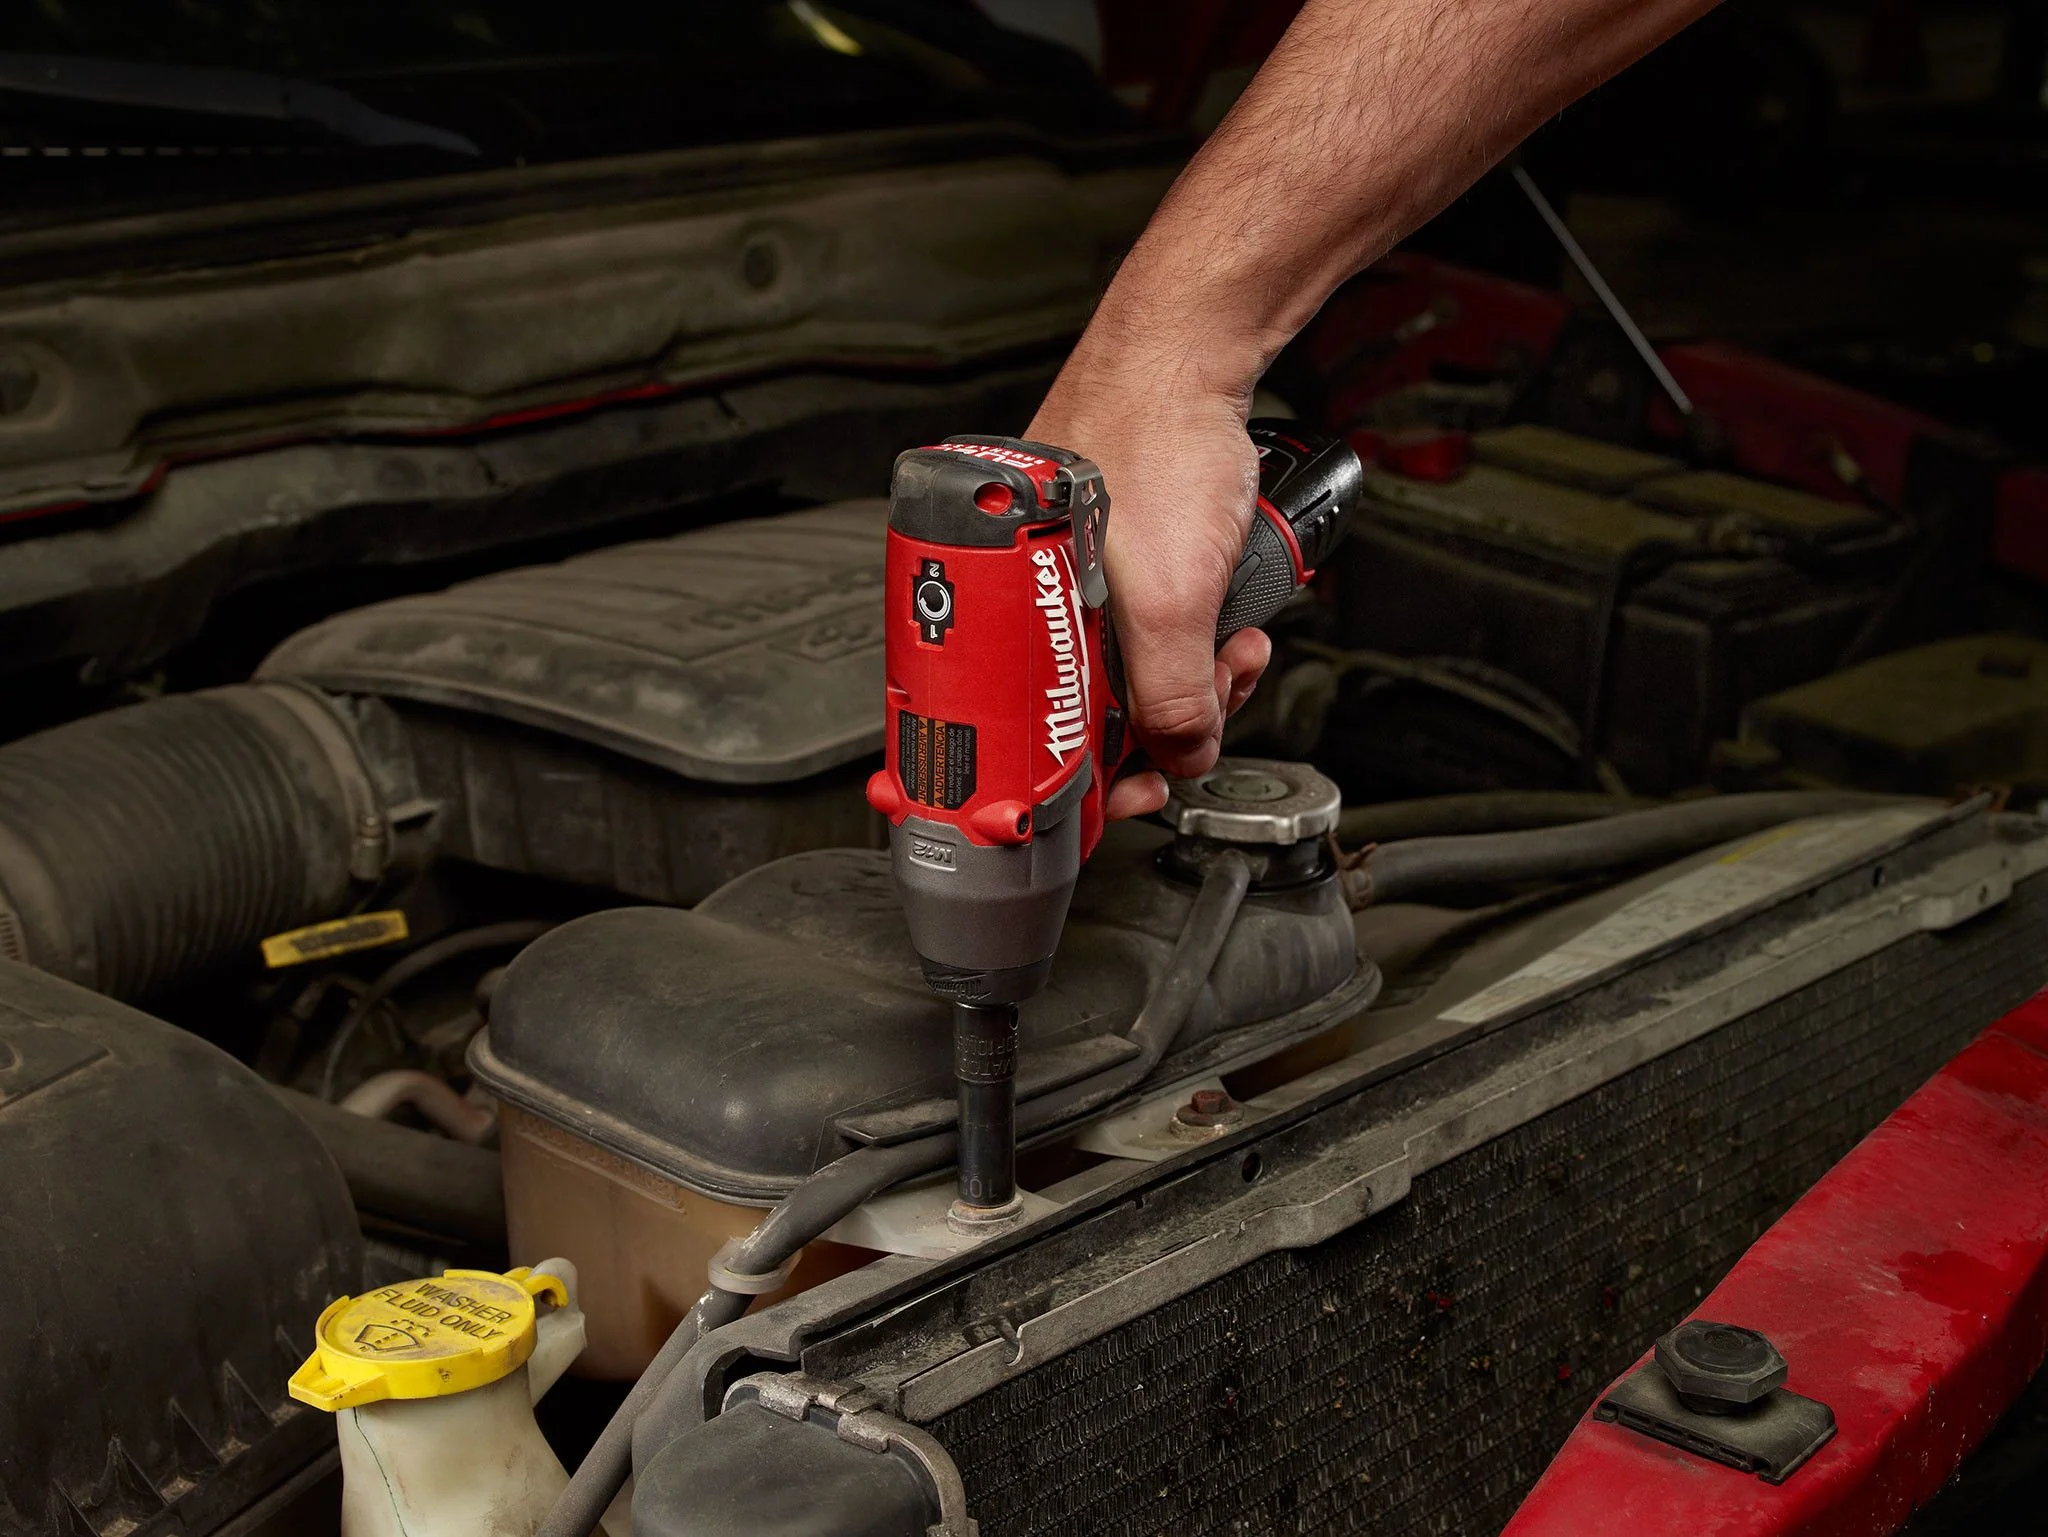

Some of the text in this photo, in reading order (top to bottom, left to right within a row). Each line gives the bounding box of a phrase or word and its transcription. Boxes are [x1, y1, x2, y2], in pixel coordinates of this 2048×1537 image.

[928, 562, 940, 578] 2
[929, 624, 938, 639] 1
[1032, 548, 1087, 767] Milwaukee
[918, 732, 927, 802] AVERTISSEMENT
[935, 726, 945, 796] ADVERTENCIA
[970, 1179, 998, 1198] 10
[373, 1288, 504, 1339] FLUID ONLY
[416, 1283, 512, 1323] WASHER
